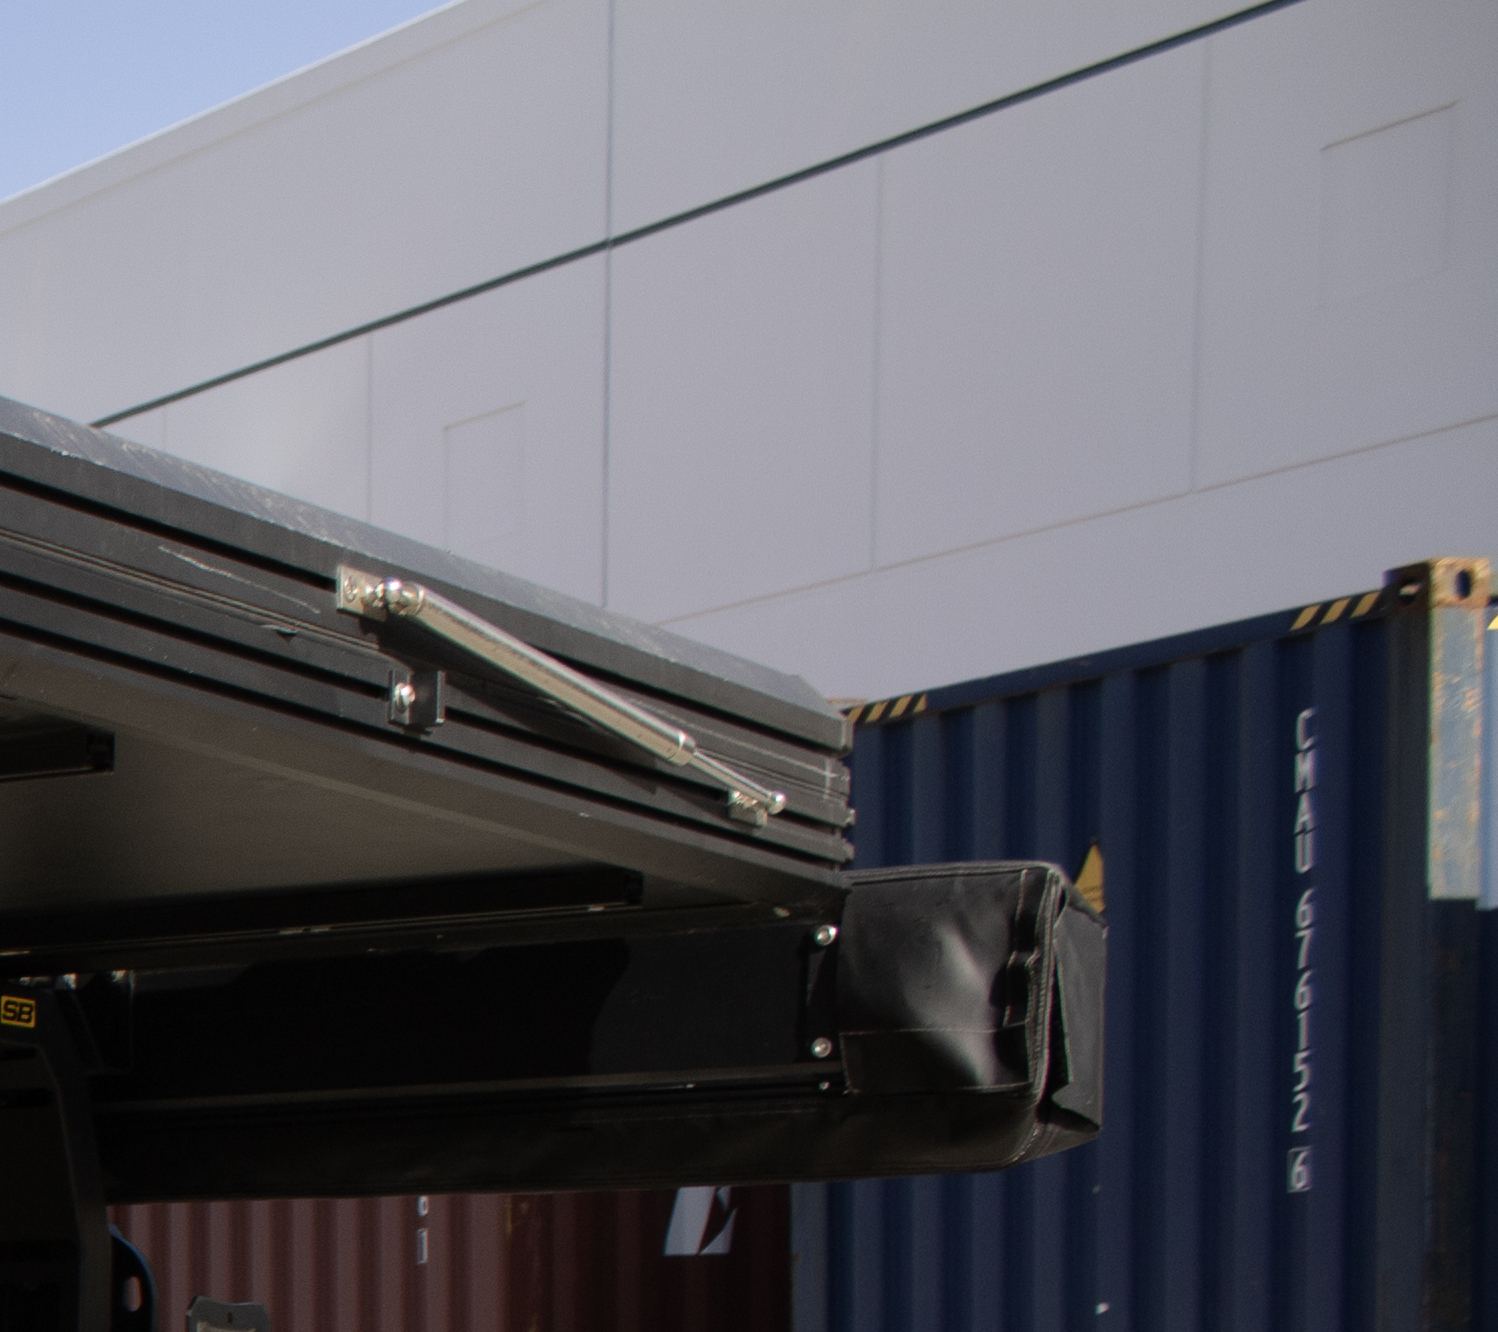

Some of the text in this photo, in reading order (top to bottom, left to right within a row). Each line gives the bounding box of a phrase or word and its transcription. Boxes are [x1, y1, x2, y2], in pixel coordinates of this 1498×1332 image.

[1293, 705, 1318, 874] CMAU
[3, 999, 34, 1024] SB
[1291, 887, 1316, 1132] 676152
